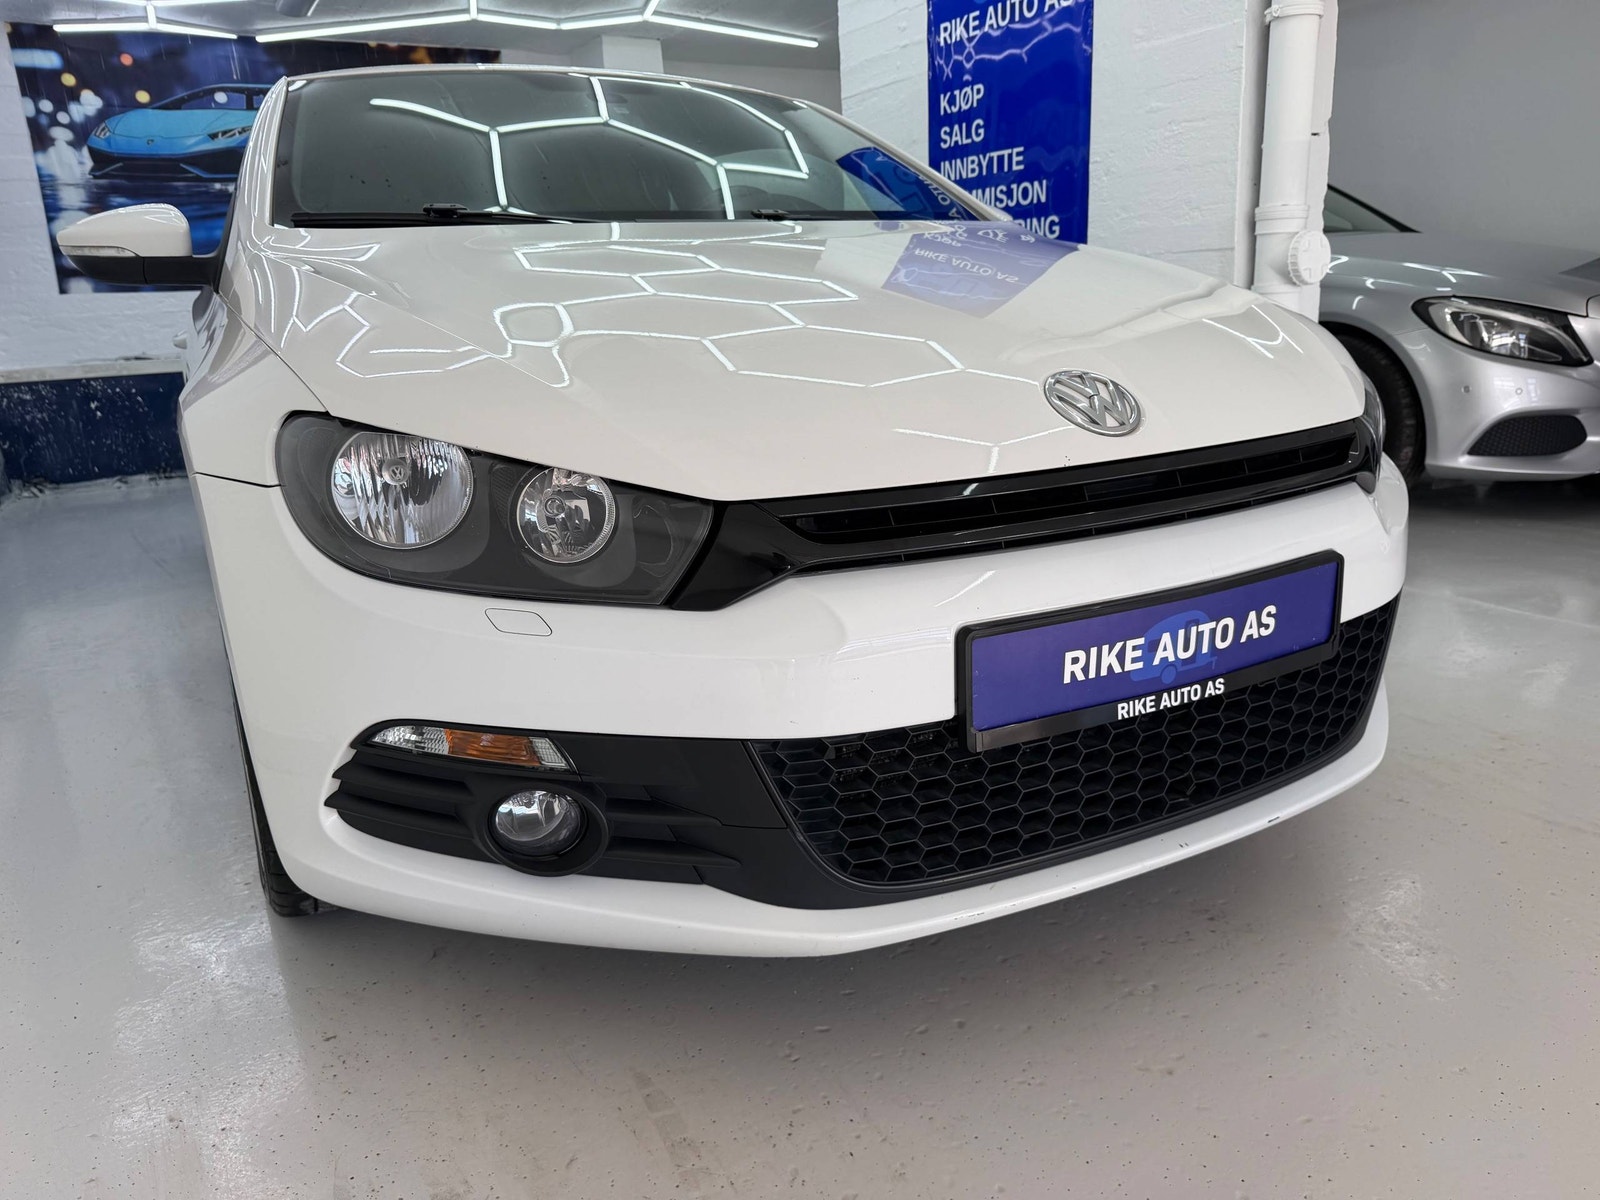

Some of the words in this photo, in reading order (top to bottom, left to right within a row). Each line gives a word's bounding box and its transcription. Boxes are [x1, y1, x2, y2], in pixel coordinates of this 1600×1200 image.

[940, 11, 980, 46] RIKE
[984, 0, 1038, 32] AUTO
[940, 83, 985, 116] KJØP
[940, 119, 985, 149] SALG
[940, 147, 1024, 181] INNBYTTE
[1063, 637, 1145, 684] RIKE
[1152, 617, 1235, 666] AUTO
[1240, 605, 1277, 643] AS
[1117, 696, 1157, 720] RIKE
[1159, 684, 1201, 710] AUTO
[1204, 678, 1225, 698] AS
